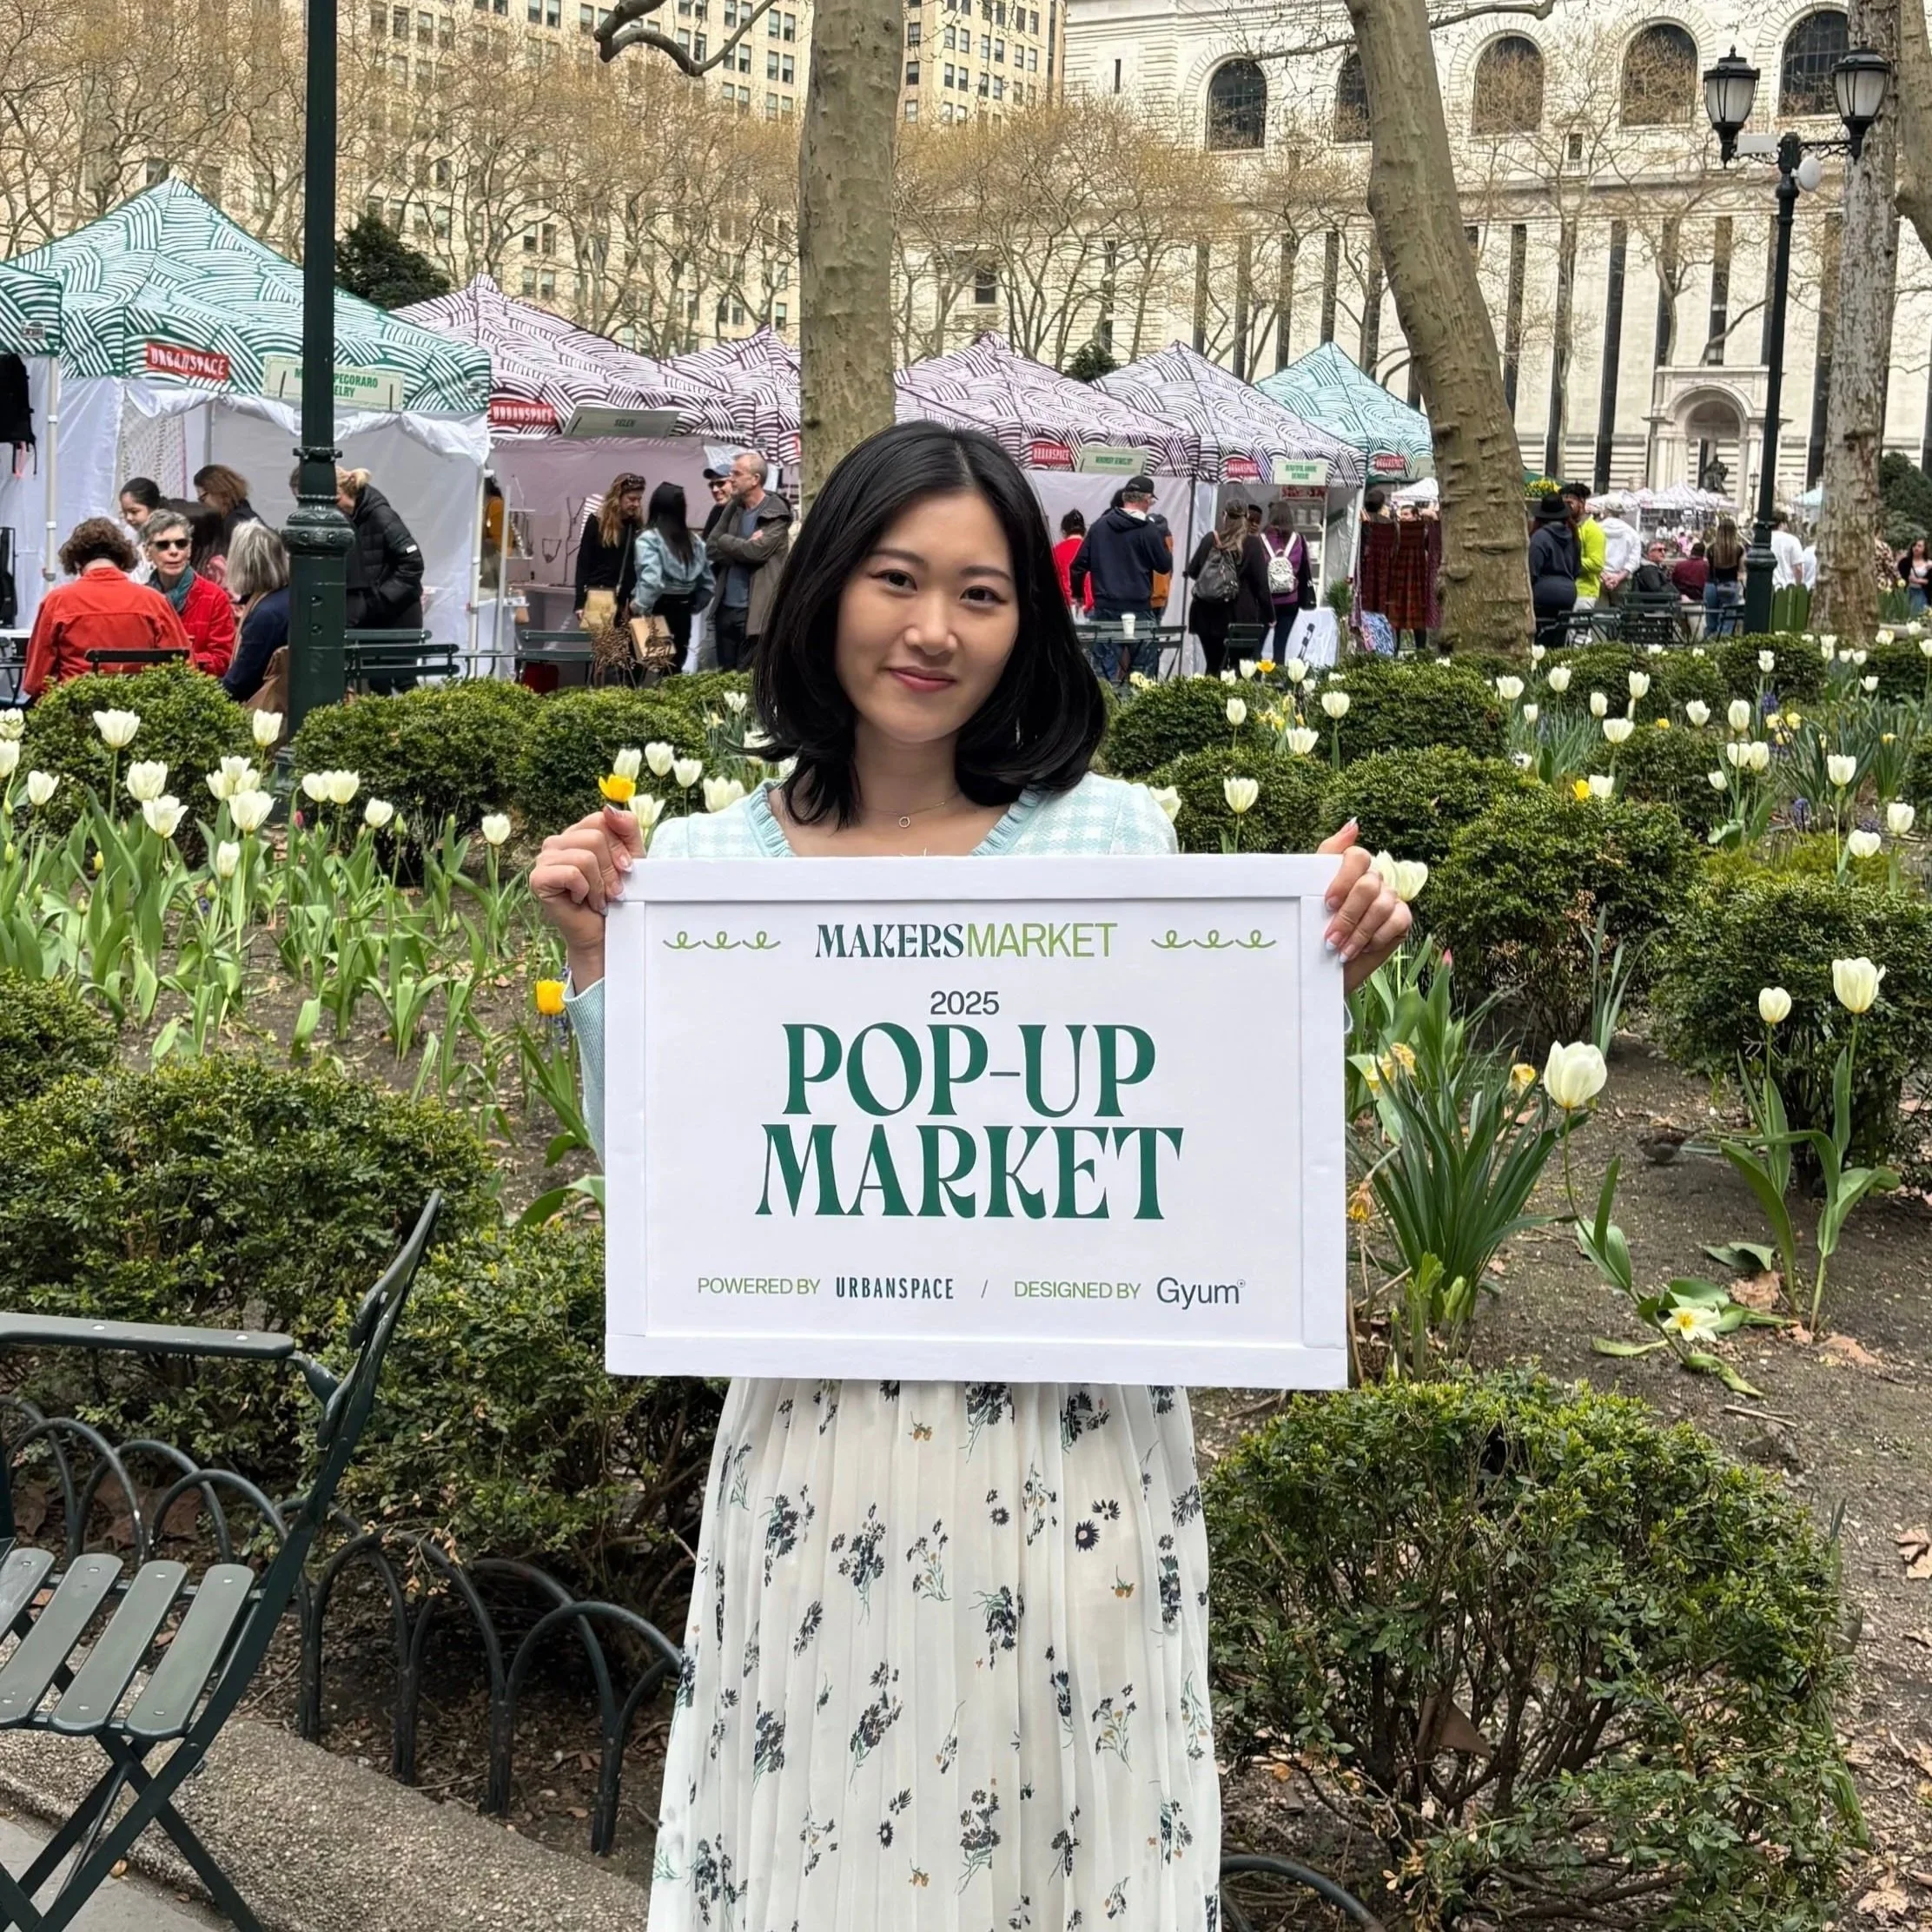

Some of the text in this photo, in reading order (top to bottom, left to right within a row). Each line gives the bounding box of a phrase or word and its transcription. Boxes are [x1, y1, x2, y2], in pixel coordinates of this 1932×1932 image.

[150, 347, 226, 375] URBANSPACE
[334, 373, 378, 388] PECORARO
[334, 385, 355, 398] ELRY
[930, 990, 1000, 1016] 2025
[781, 1022, 1156, 1119] POP-UP
[754, 1123, 1185, 1221] MARKET
[698, 1277, 793, 1294] POWERED
[797, 1278, 821, 1295] BY
[836, 1276, 954, 1300] URBANSPACE
[1015, 1280, 1113, 1299] DESIGNED
[1116, 1281, 1141, 1300] BY
